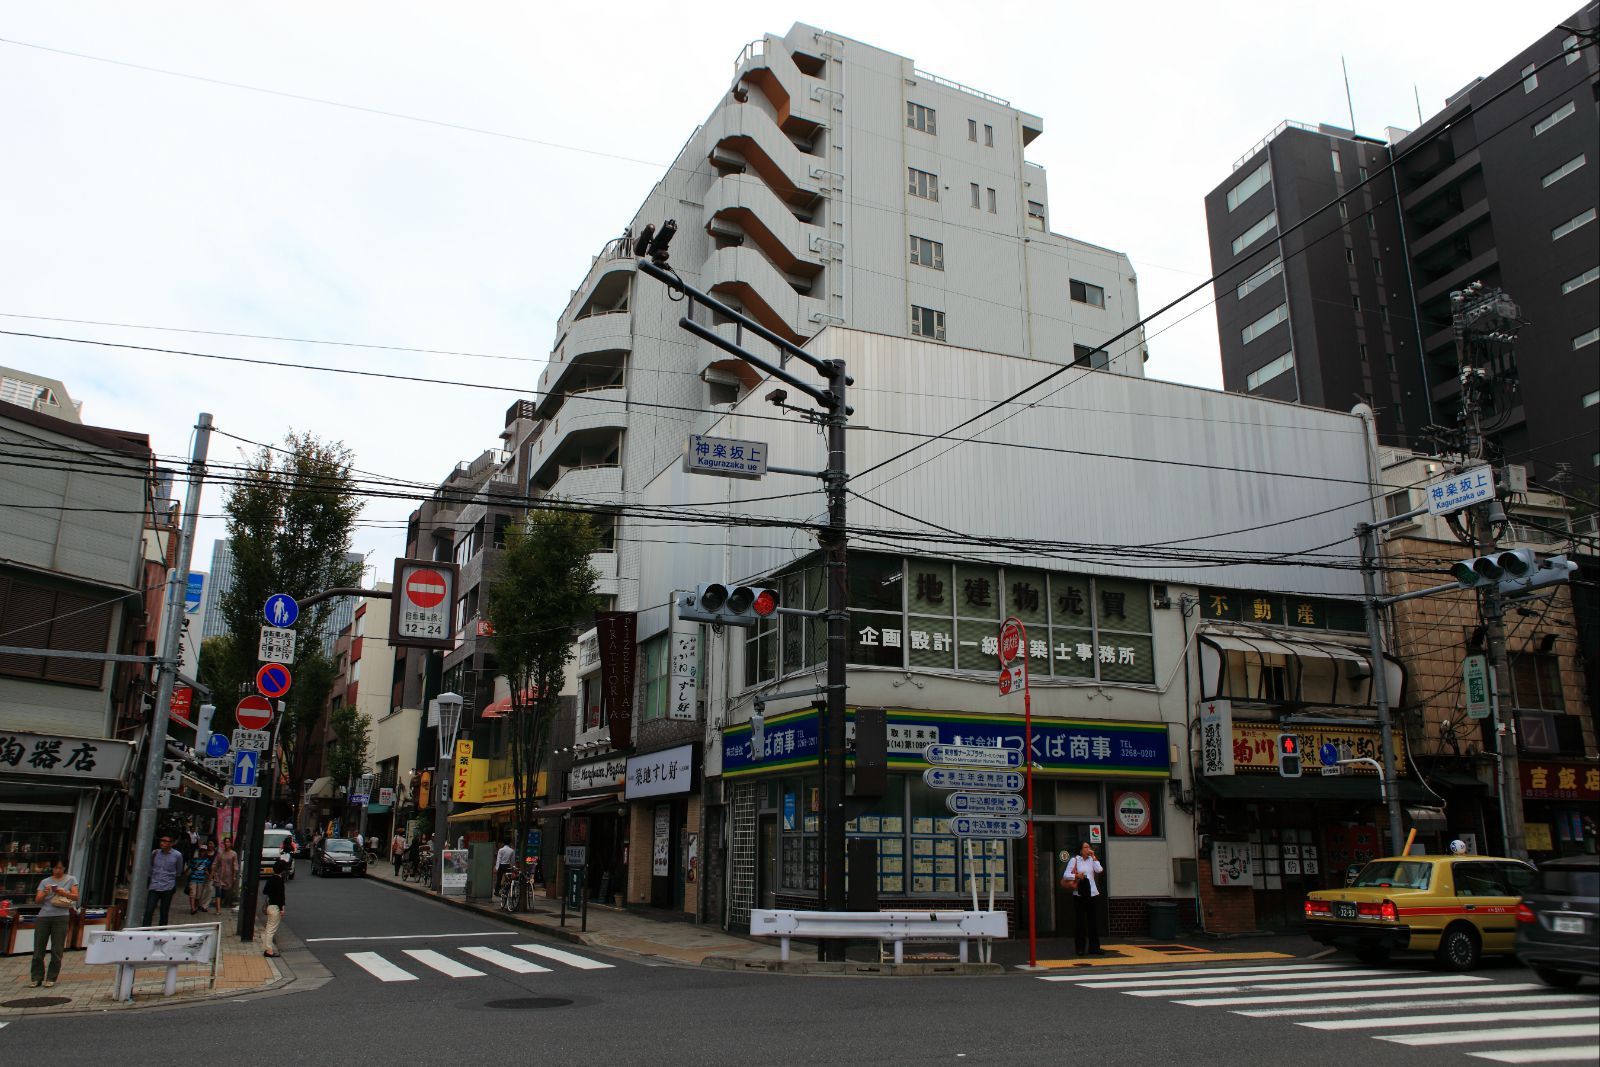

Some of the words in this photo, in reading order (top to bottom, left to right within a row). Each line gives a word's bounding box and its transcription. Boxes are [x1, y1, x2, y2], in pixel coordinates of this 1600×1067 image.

[695, 441, 761, 462] 神楽坂上
[698, 457, 744, 469] Kagurazaka
[1431, 474, 1488, 501] 神楽坂上
[1436, 492, 1475, 509] Kagurazaka
[1477, 489, 1486, 497] ue
[1209, 594, 1315, 625] 不動産
[858, 626, 1135, 665] 企画設計一級築士事務所
[726, 744, 744, 757] 株式会社
[1004, 734, 1112, 760] つくば商事
[1120, 740, 1132, 748] TEL
[1121, 748, 1157, 758] 3268-0201
[1233, 738, 1275, 765] 菊川
[635, 760, 678, 786] 築地すし好
[948, 771, 1004, 783] 厚生年金病院
